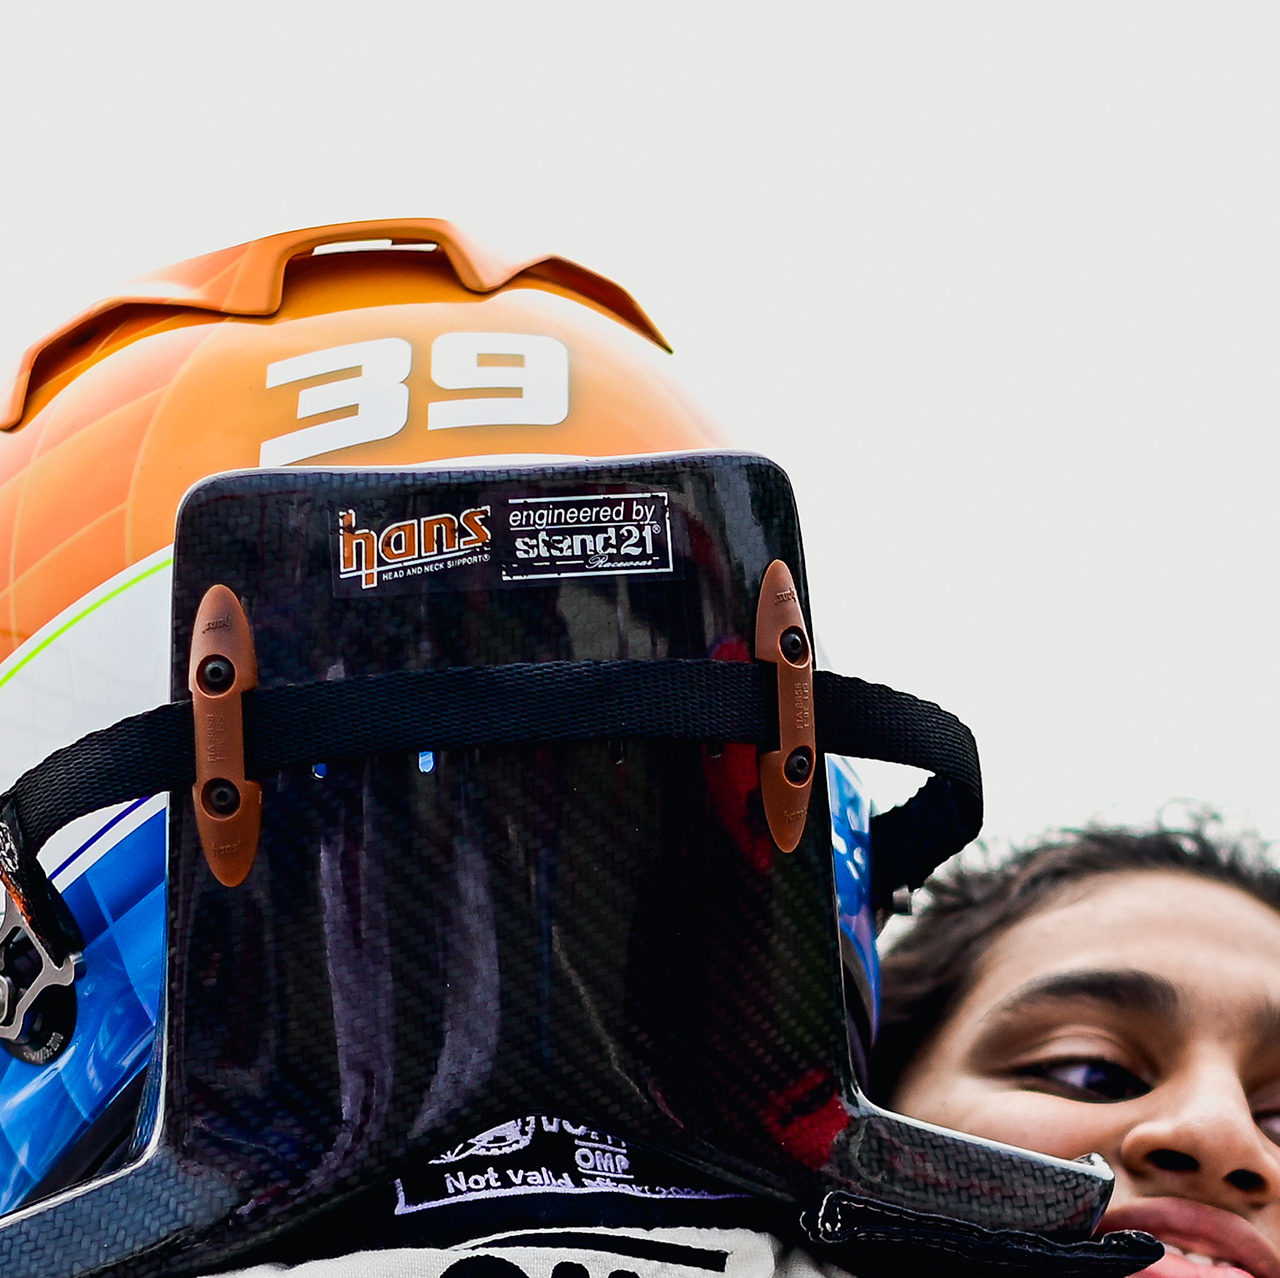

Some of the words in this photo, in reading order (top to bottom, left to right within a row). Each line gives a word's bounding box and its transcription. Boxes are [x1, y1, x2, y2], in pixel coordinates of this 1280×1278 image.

[259, 332, 569, 467] 39
[508, 502, 625, 529] engineered
[632, 500, 656, 524] by
[339, 505, 492, 589] hans
[382, 570, 405, 582] HEAD
[406, 566, 423, 577] AND
[424, 563, 445, 574] NECK
[575, 1148, 631, 1174] OMP
[445, 1167, 499, 1194] Not
[506, 1166, 576, 1189] valid
